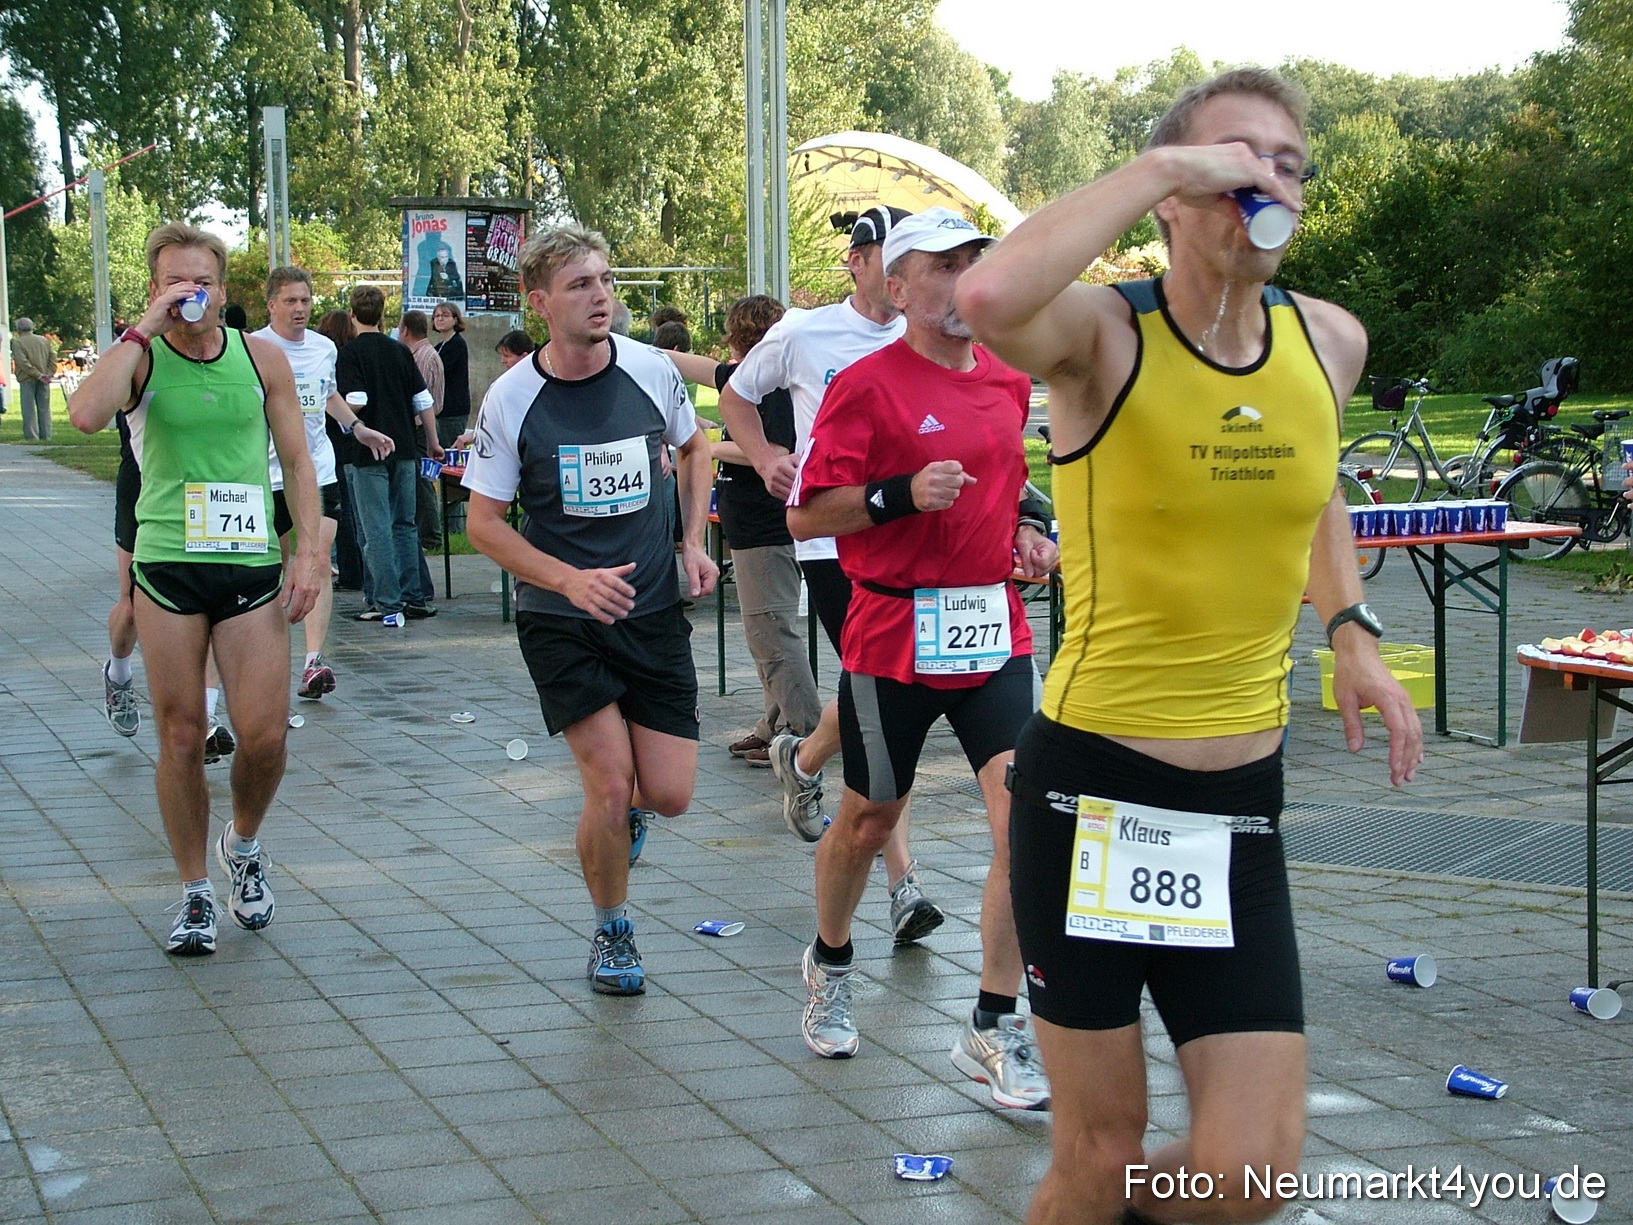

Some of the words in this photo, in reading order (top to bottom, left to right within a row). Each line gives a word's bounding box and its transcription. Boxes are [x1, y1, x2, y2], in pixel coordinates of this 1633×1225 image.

[415, 213, 435, 221] Bruno
[411, 218, 448, 239] Jonas
[297, 383, 310, 391] rgen
[918, 423, 946, 435] adidas
[1221, 422, 1264, 433] skinfit
[584, 450, 623, 467] Philipp
[1189, 445, 1208, 460] TV
[1213, 444, 1296, 462] Hilpoltstein
[1210, 467, 1276, 481] Triathlon
[564, 474, 571, 485] A
[588, 470, 644, 497] 3344
[210, 488, 248, 504] Michael
[189, 509, 196, 520] B
[219, 513, 256, 533] 714
[944, 594, 987, 613] Ludwig
[920, 621, 927, 633] A
[947, 623, 1003, 649] 2277
[1119, 815, 1171, 846] Klaus
[1080, 851, 1089, 870] B
[1130, 866, 1202, 909] 888
[1069, 915, 1128, 933] BOCK
[1166, 925, 1230, 939] PFLEIDERER
